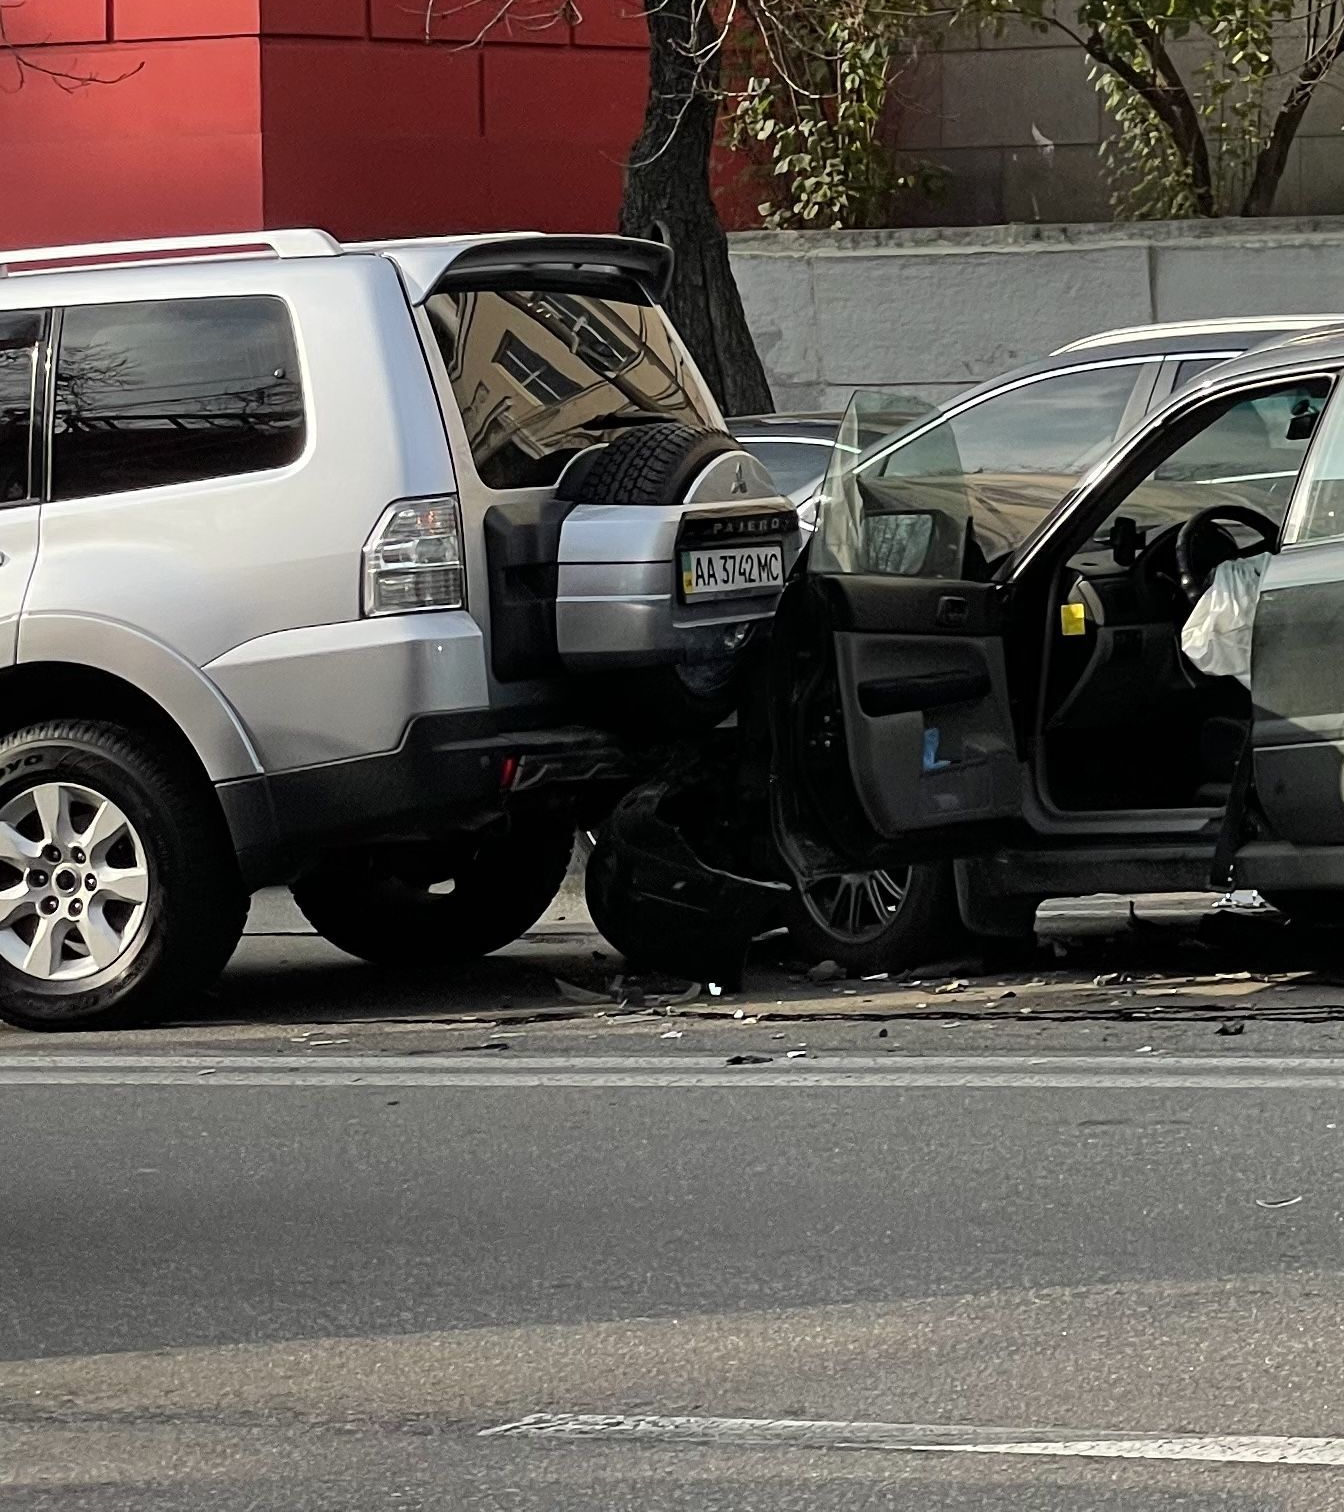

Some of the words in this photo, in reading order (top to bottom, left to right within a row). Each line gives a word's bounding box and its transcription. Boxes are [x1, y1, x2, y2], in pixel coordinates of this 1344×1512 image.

[713, 518, 780, 534] PAJERO
[695, 557, 718, 587] AA
[719, 554, 756, 585] 3742
[757, 553, 780, 584] MC
